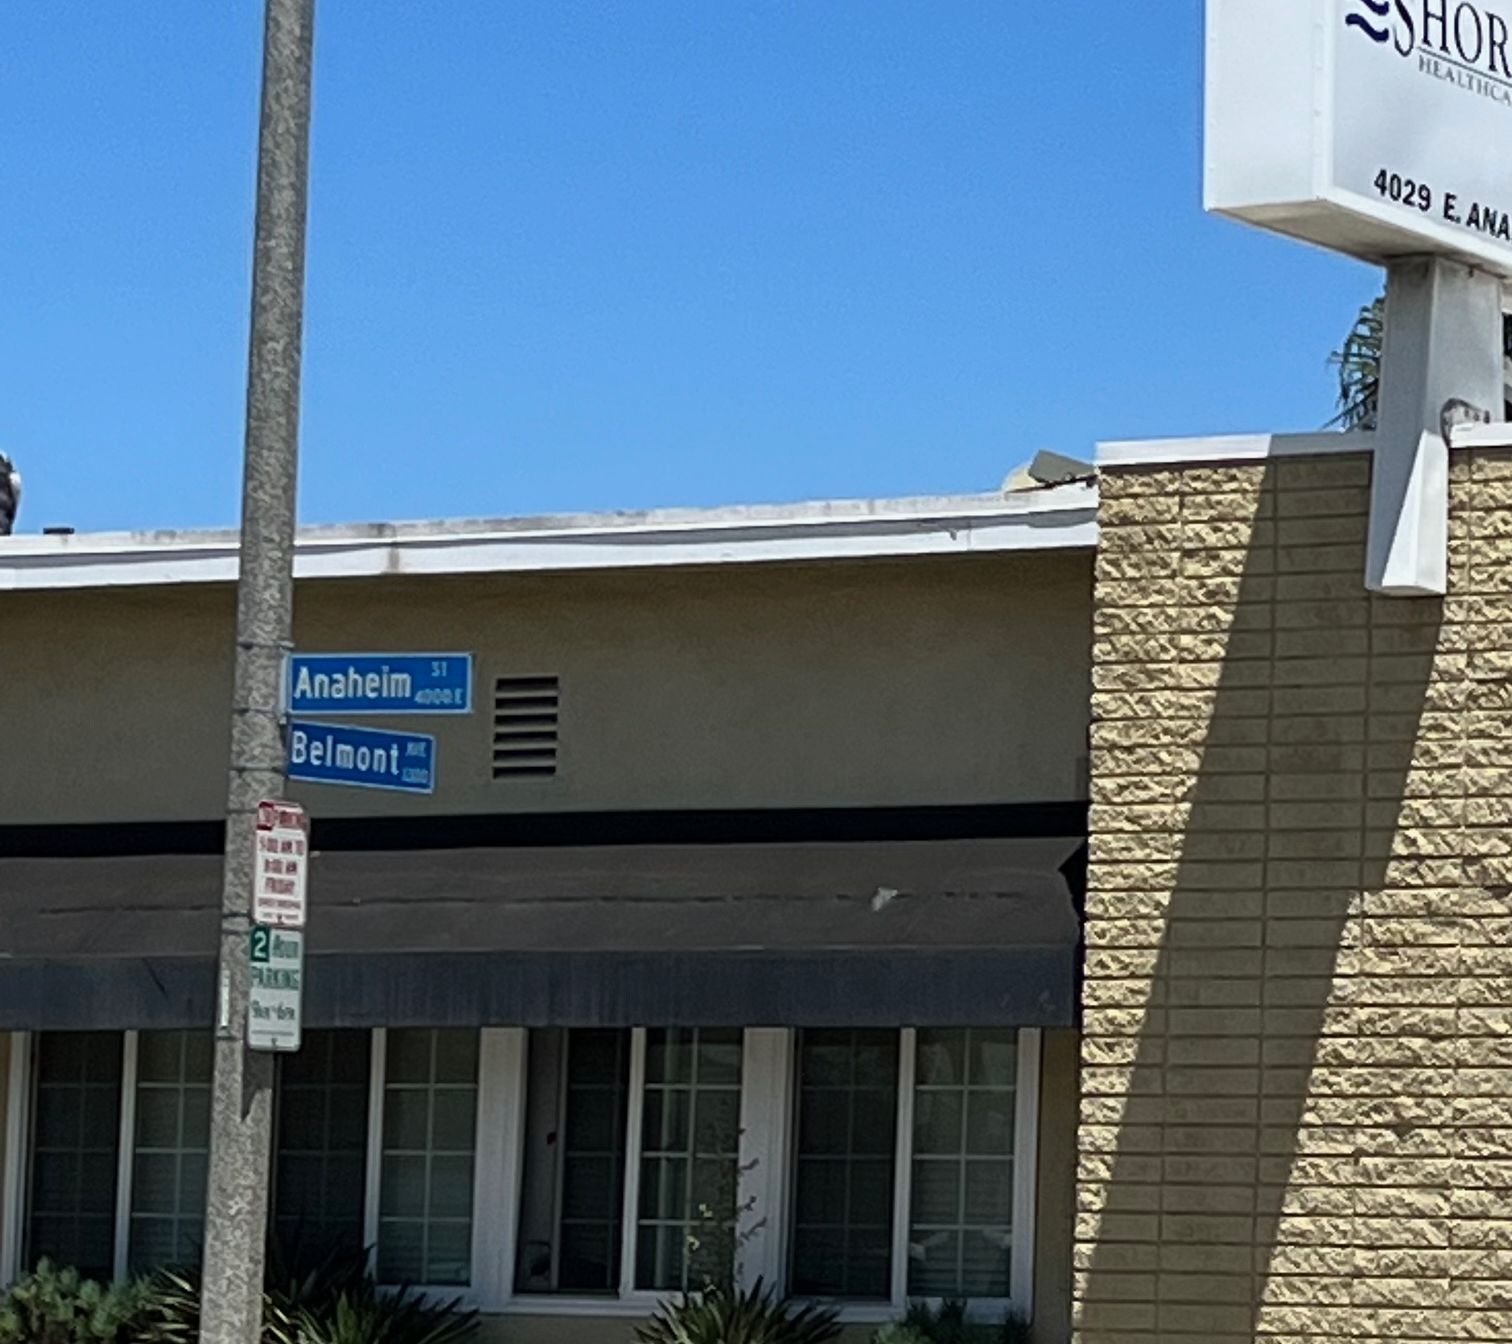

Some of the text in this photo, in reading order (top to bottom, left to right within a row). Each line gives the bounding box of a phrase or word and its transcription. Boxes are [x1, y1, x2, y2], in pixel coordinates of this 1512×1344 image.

[1374, 168, 1431, 212] 4029
[1443, 192, 1461, 223] E.
[294, 666, 411, 698] Anaheim
[292, 731, 399, 775] Belmont
[253, 930, 267, 958] 2
